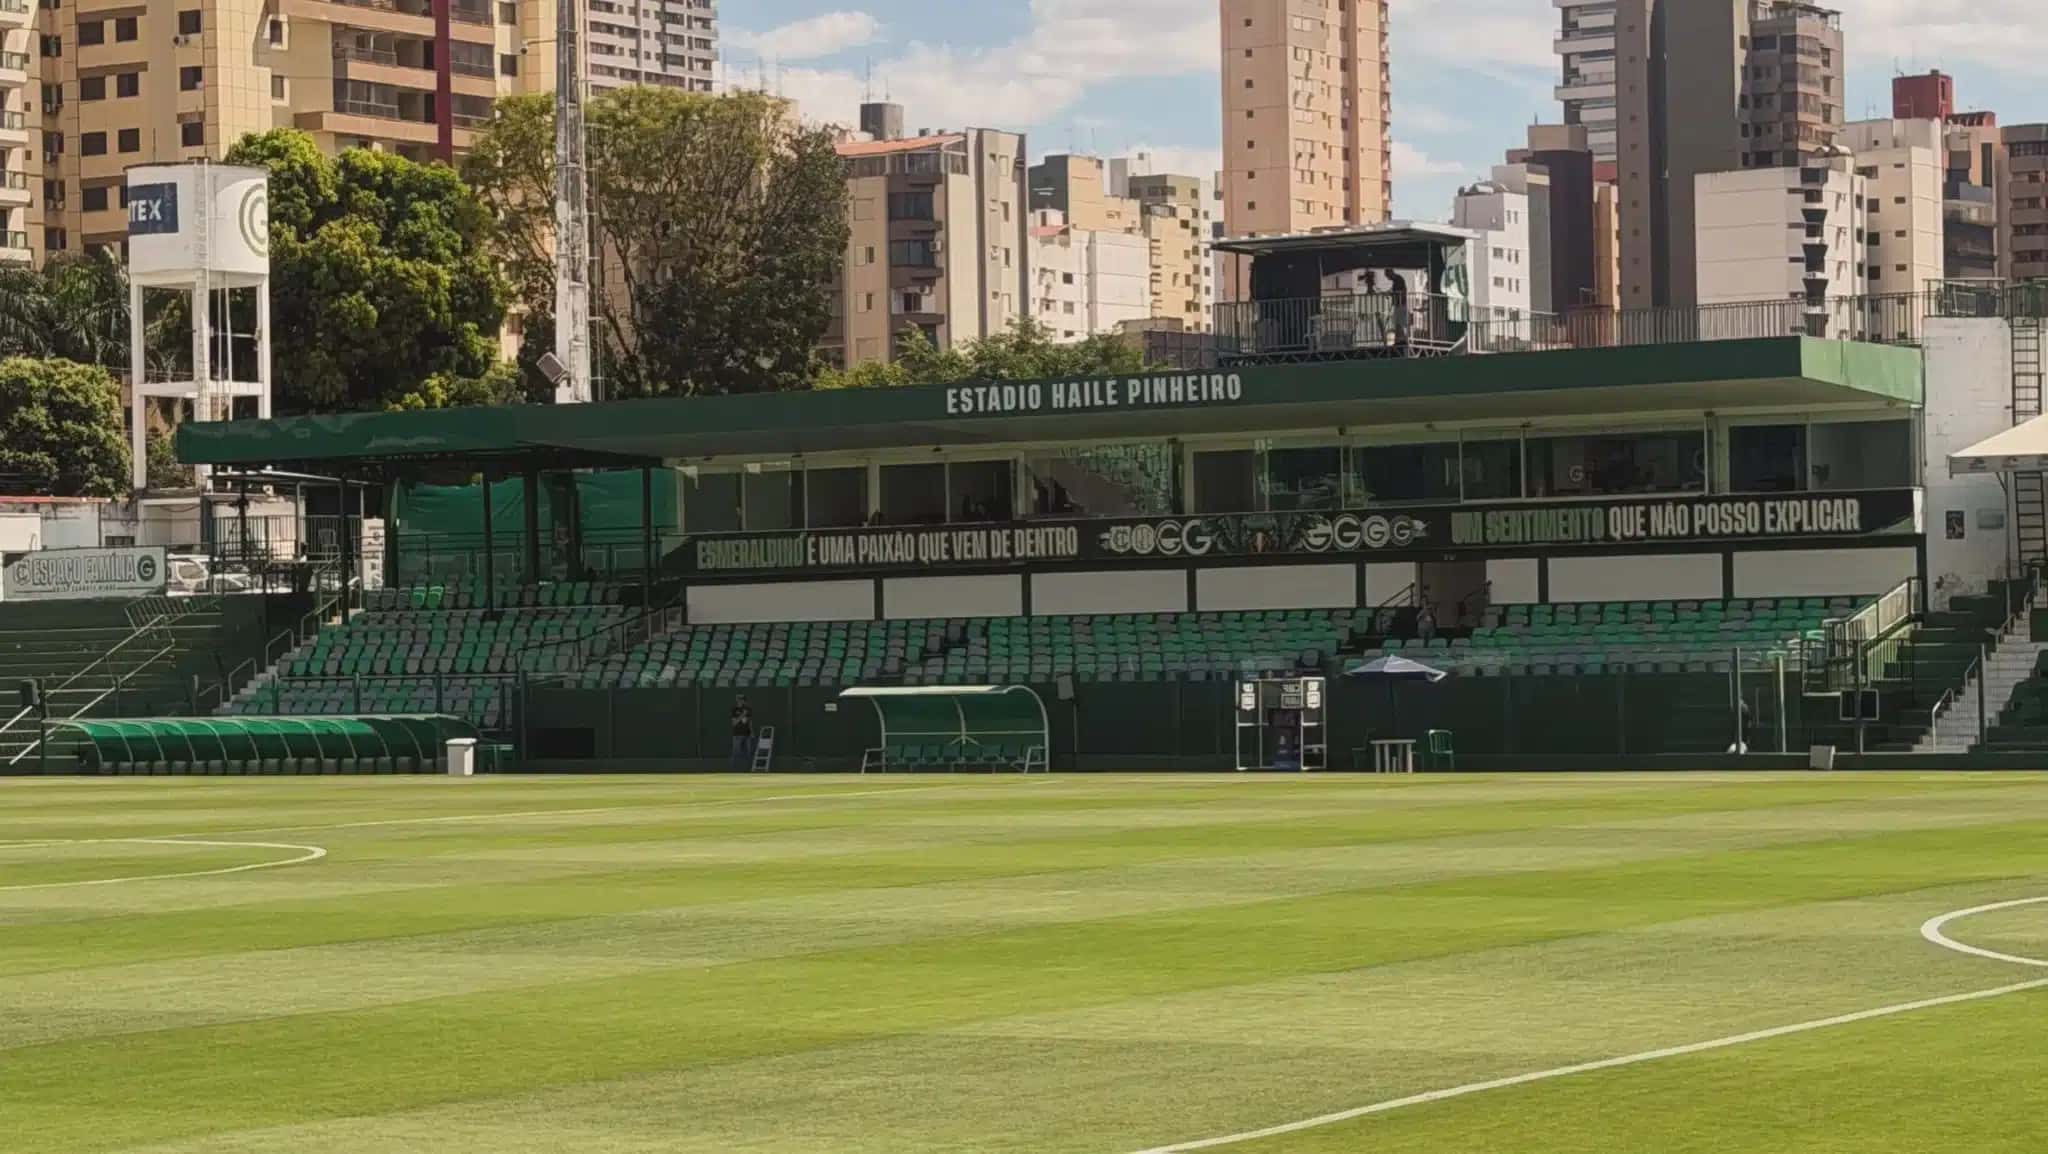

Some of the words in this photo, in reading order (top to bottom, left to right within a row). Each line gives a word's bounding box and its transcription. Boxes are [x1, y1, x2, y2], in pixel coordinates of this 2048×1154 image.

[1052, 380, 1118, 409] HAILE
[1128, 373, 1242, 404] PINHEIRO
[1485, 507, 1604, 542] SENTIMENTO
[1609, 505, 1646, 540] QUE
[1651, 502, 1689, 536] NÃO
[1693, 502, 1760, 535] POSSO
[1764, 499, 1861, 532] EXPLICAR
[819, 535, 855, 565] UMA
[858, 531, 915, 564] PAIXÃO
[918, 532, 950, 564] QUE
[952, 530, 987, 560] VEM
[991, 529, 1011, 558] DE
[1014, 526, 1078, 557] DENTRO
[32, 557, 82, 586] ESPAÇO
